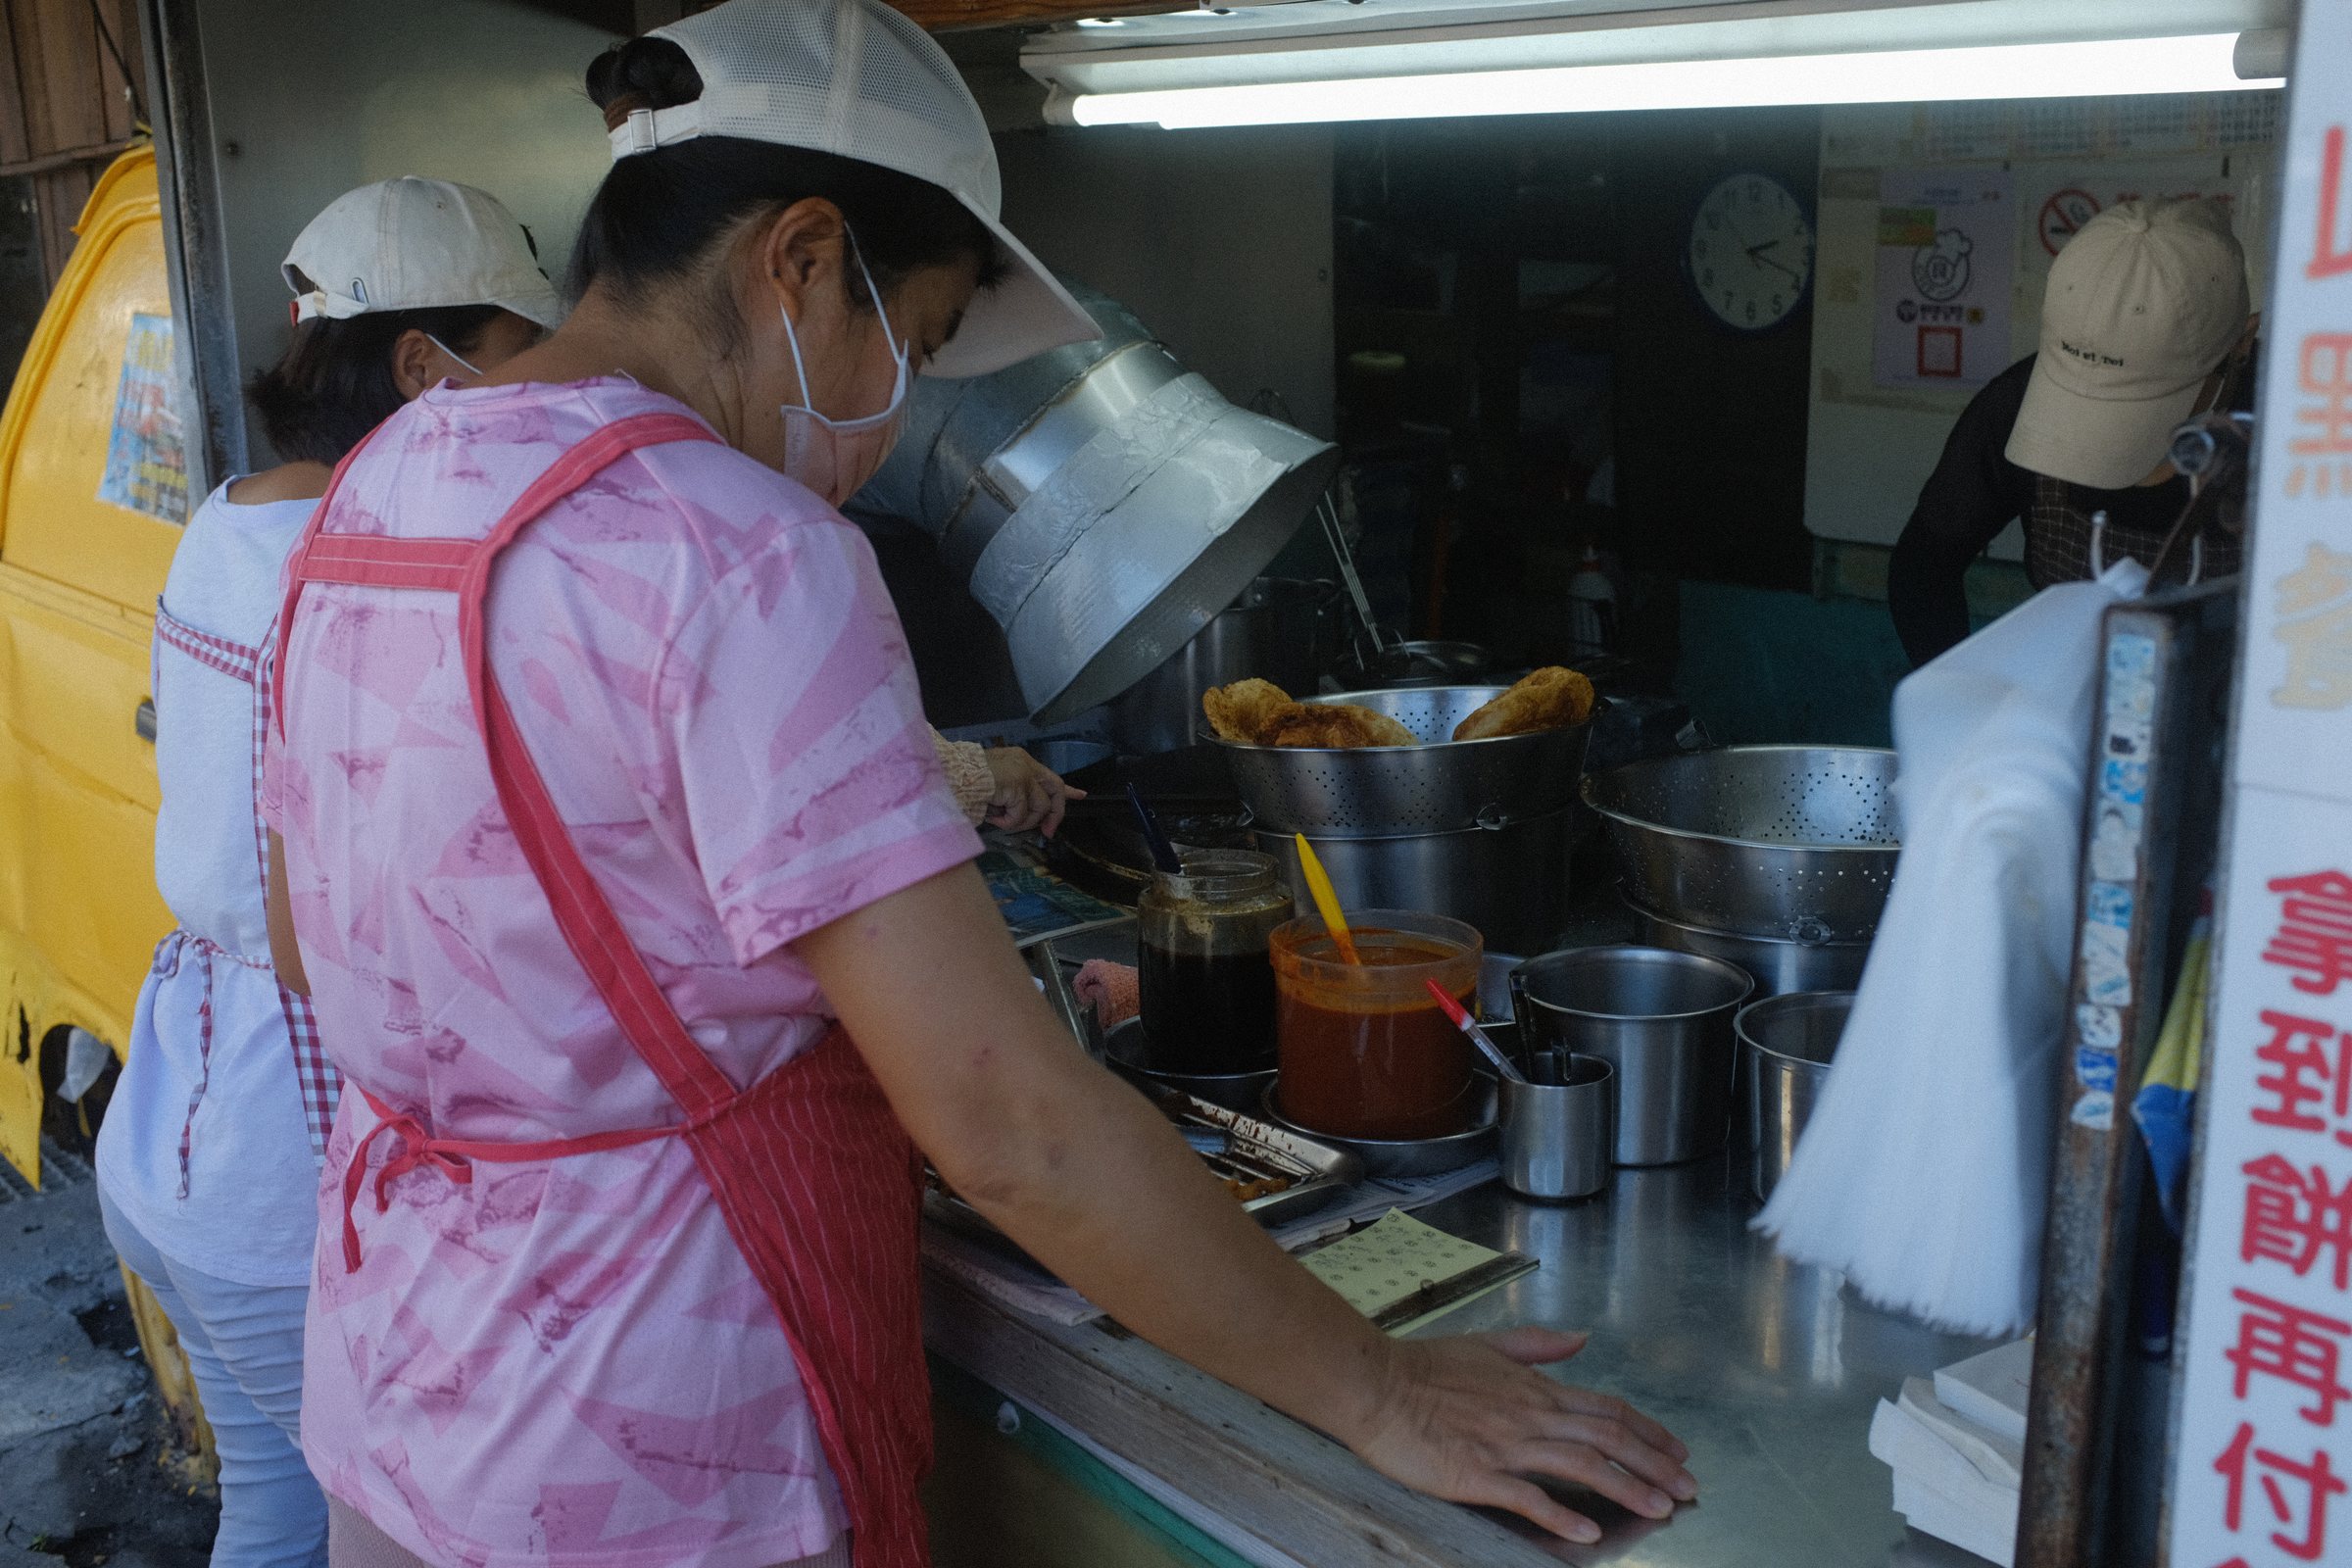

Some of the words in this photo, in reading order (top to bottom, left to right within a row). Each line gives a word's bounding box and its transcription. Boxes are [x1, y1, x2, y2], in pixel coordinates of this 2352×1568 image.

[1723, 290, 1734, 311] 7
[1772, 294, 1783, 315] 5
[2210, 870, 2352, 1568] 拿到餅再付
